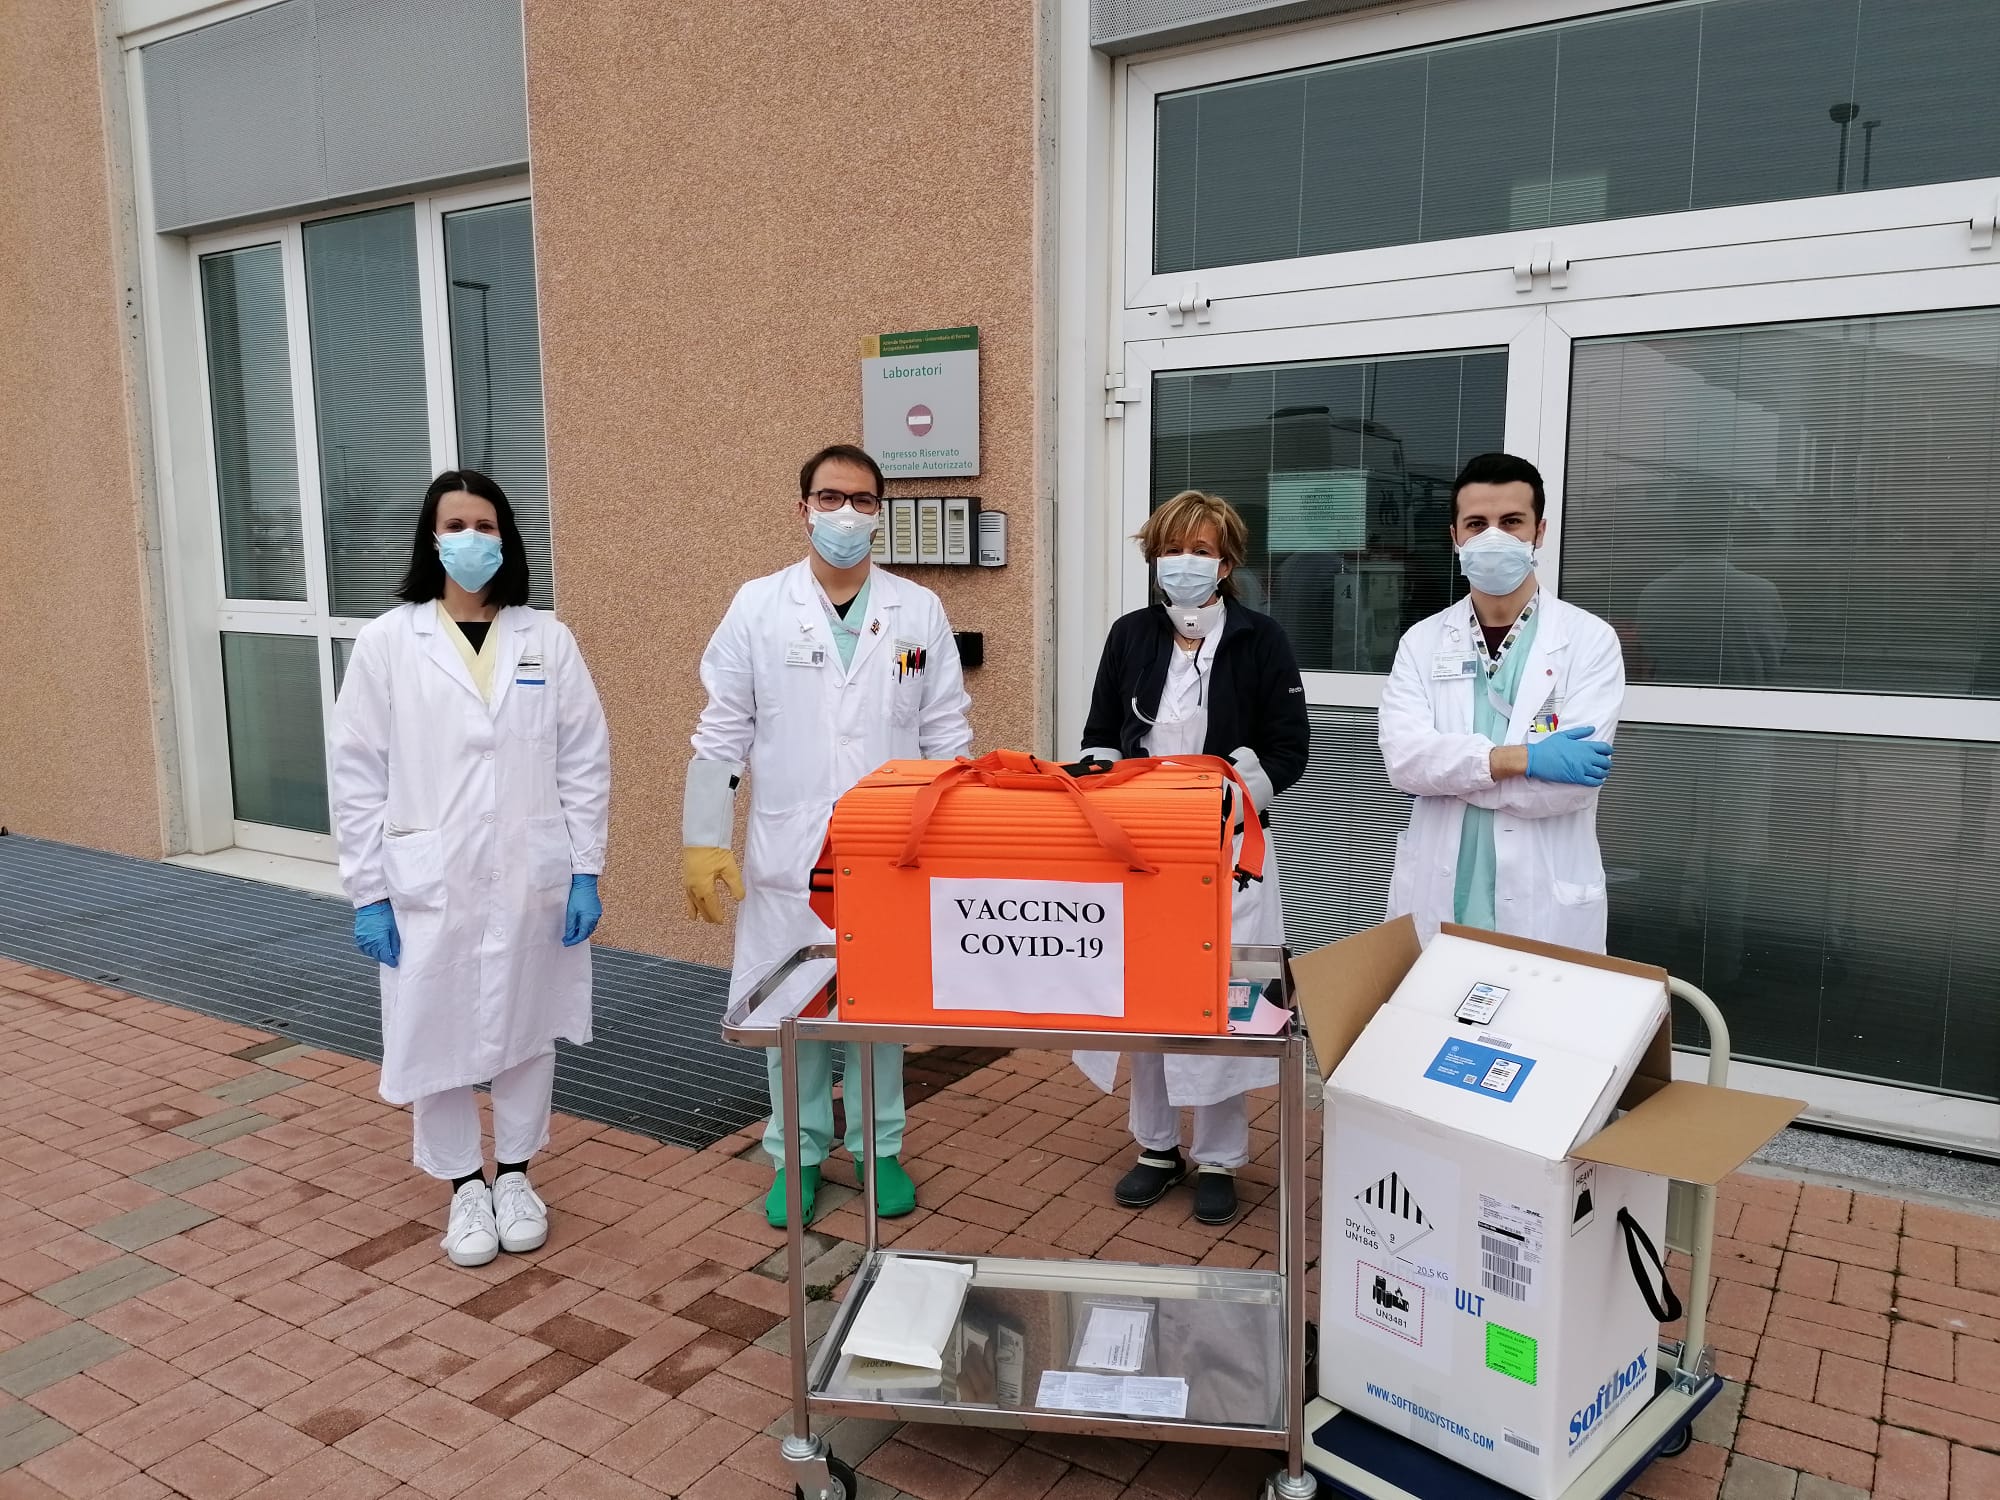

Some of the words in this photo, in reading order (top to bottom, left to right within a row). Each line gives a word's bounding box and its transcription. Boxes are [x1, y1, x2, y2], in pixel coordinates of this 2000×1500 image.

[883, 363, 942, 379] Laboratori
[882, 450, 917, 460] Ingresso
[920, 448, 959, 457] Riservato
[880, 461, 920, 471] Personale
[922, 460, 973, 470] Autorizzato
[954, 898, 1105, 924] VACCINO
[960, 933, 1104, 959] COVID-19
[1575, 1165, 1594, 1188] HEAVY
[1345, 1217, 1361, 1231] Dry
[1363, 1225, 1377, 1237] Ice
[1389, 1233, 1396, 1242] 9
[1345, 1229, 1379, 1250] UN1845
[1436, 1270, 1449, 1281] KG
[1455, 1287, 1485, 1318] ULT
[1375, 1307, 1408, 1329] UN3481
[1568, 1346, 1649, 1446] Softbox
[1366, 1381, 1494, 1452] WWW.SOFTBOXSYSTEMS.COM
